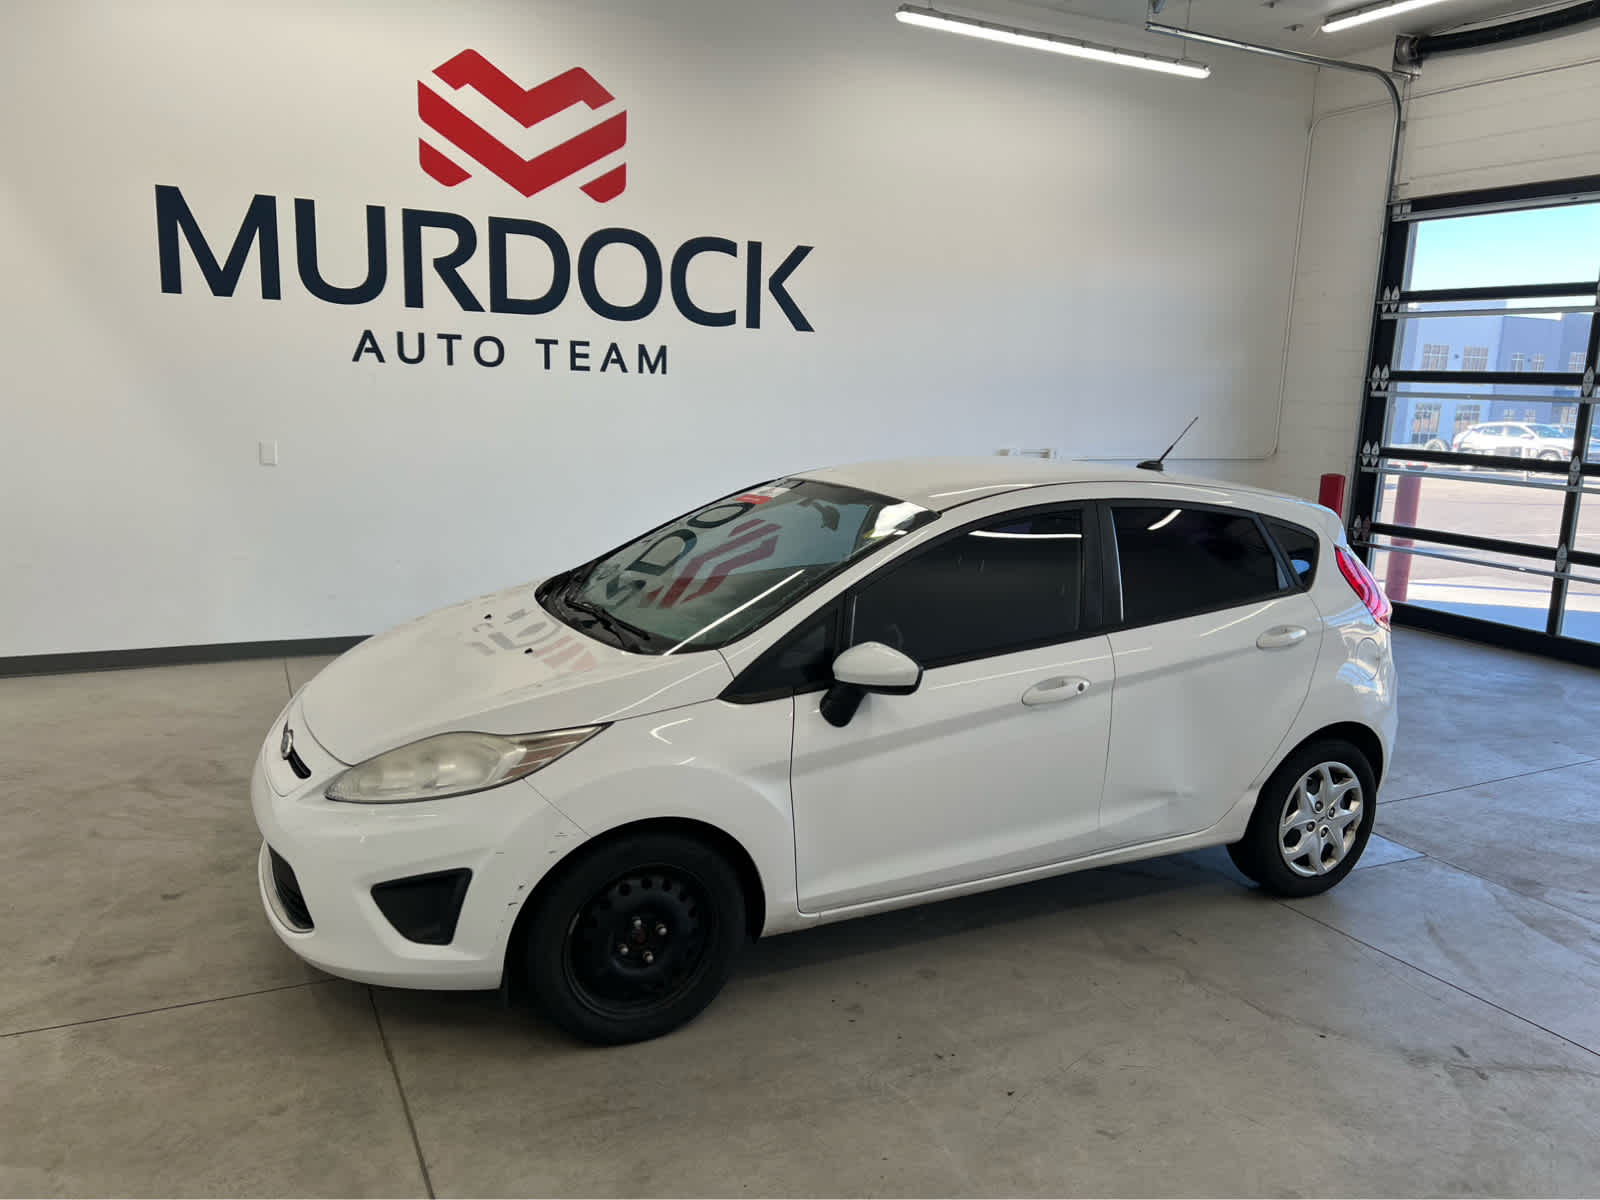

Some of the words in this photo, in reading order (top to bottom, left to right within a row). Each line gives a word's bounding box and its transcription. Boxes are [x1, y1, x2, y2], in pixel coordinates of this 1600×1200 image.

[154, 184, 815, 333] MURDOCK
[352, 329, 505, 368] AUTO
[535, 338, 668, 375] TEAM
